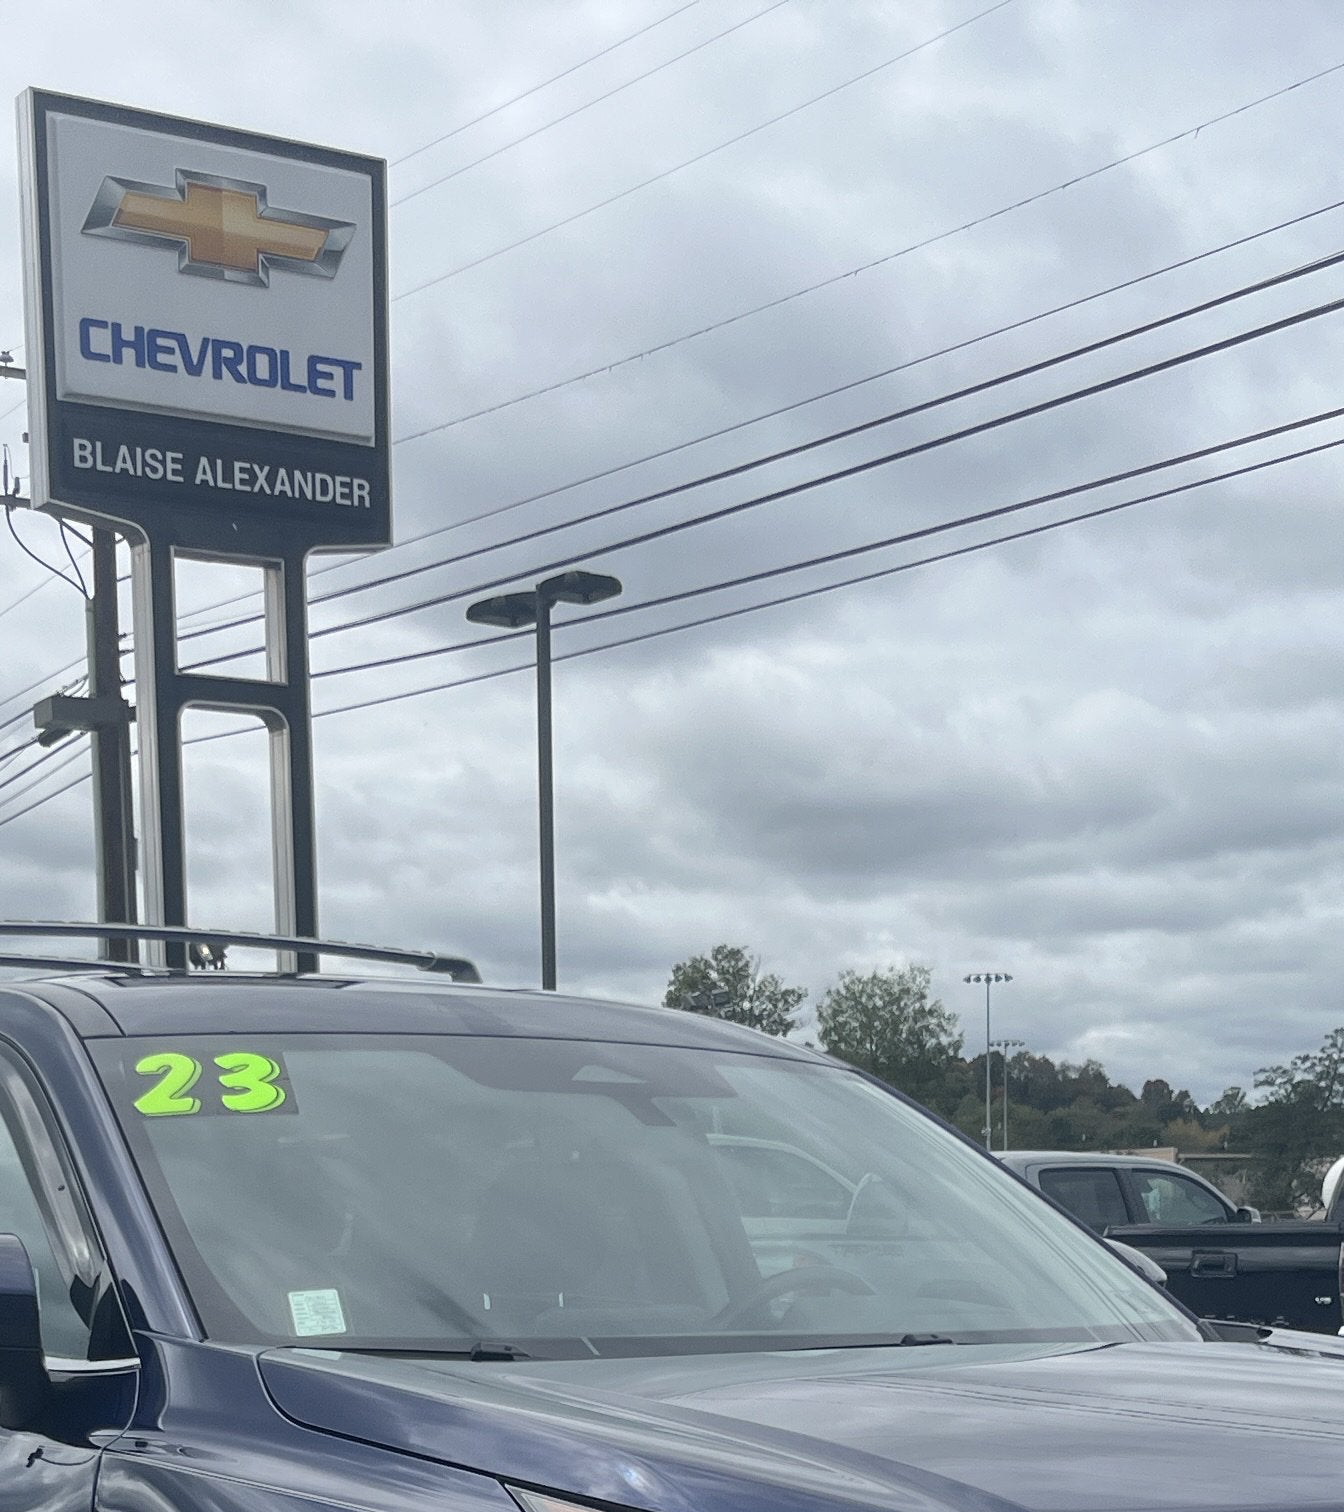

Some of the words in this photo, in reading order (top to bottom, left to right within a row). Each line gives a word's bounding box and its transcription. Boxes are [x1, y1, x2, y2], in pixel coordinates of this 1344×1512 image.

[79, 317, 362, 401] CHEVROLET
[73, 438, 184, 482] BLAISE
[195, 456, 371, 508] ALEXANDER
[134, 1053, 286, 1117] 23
